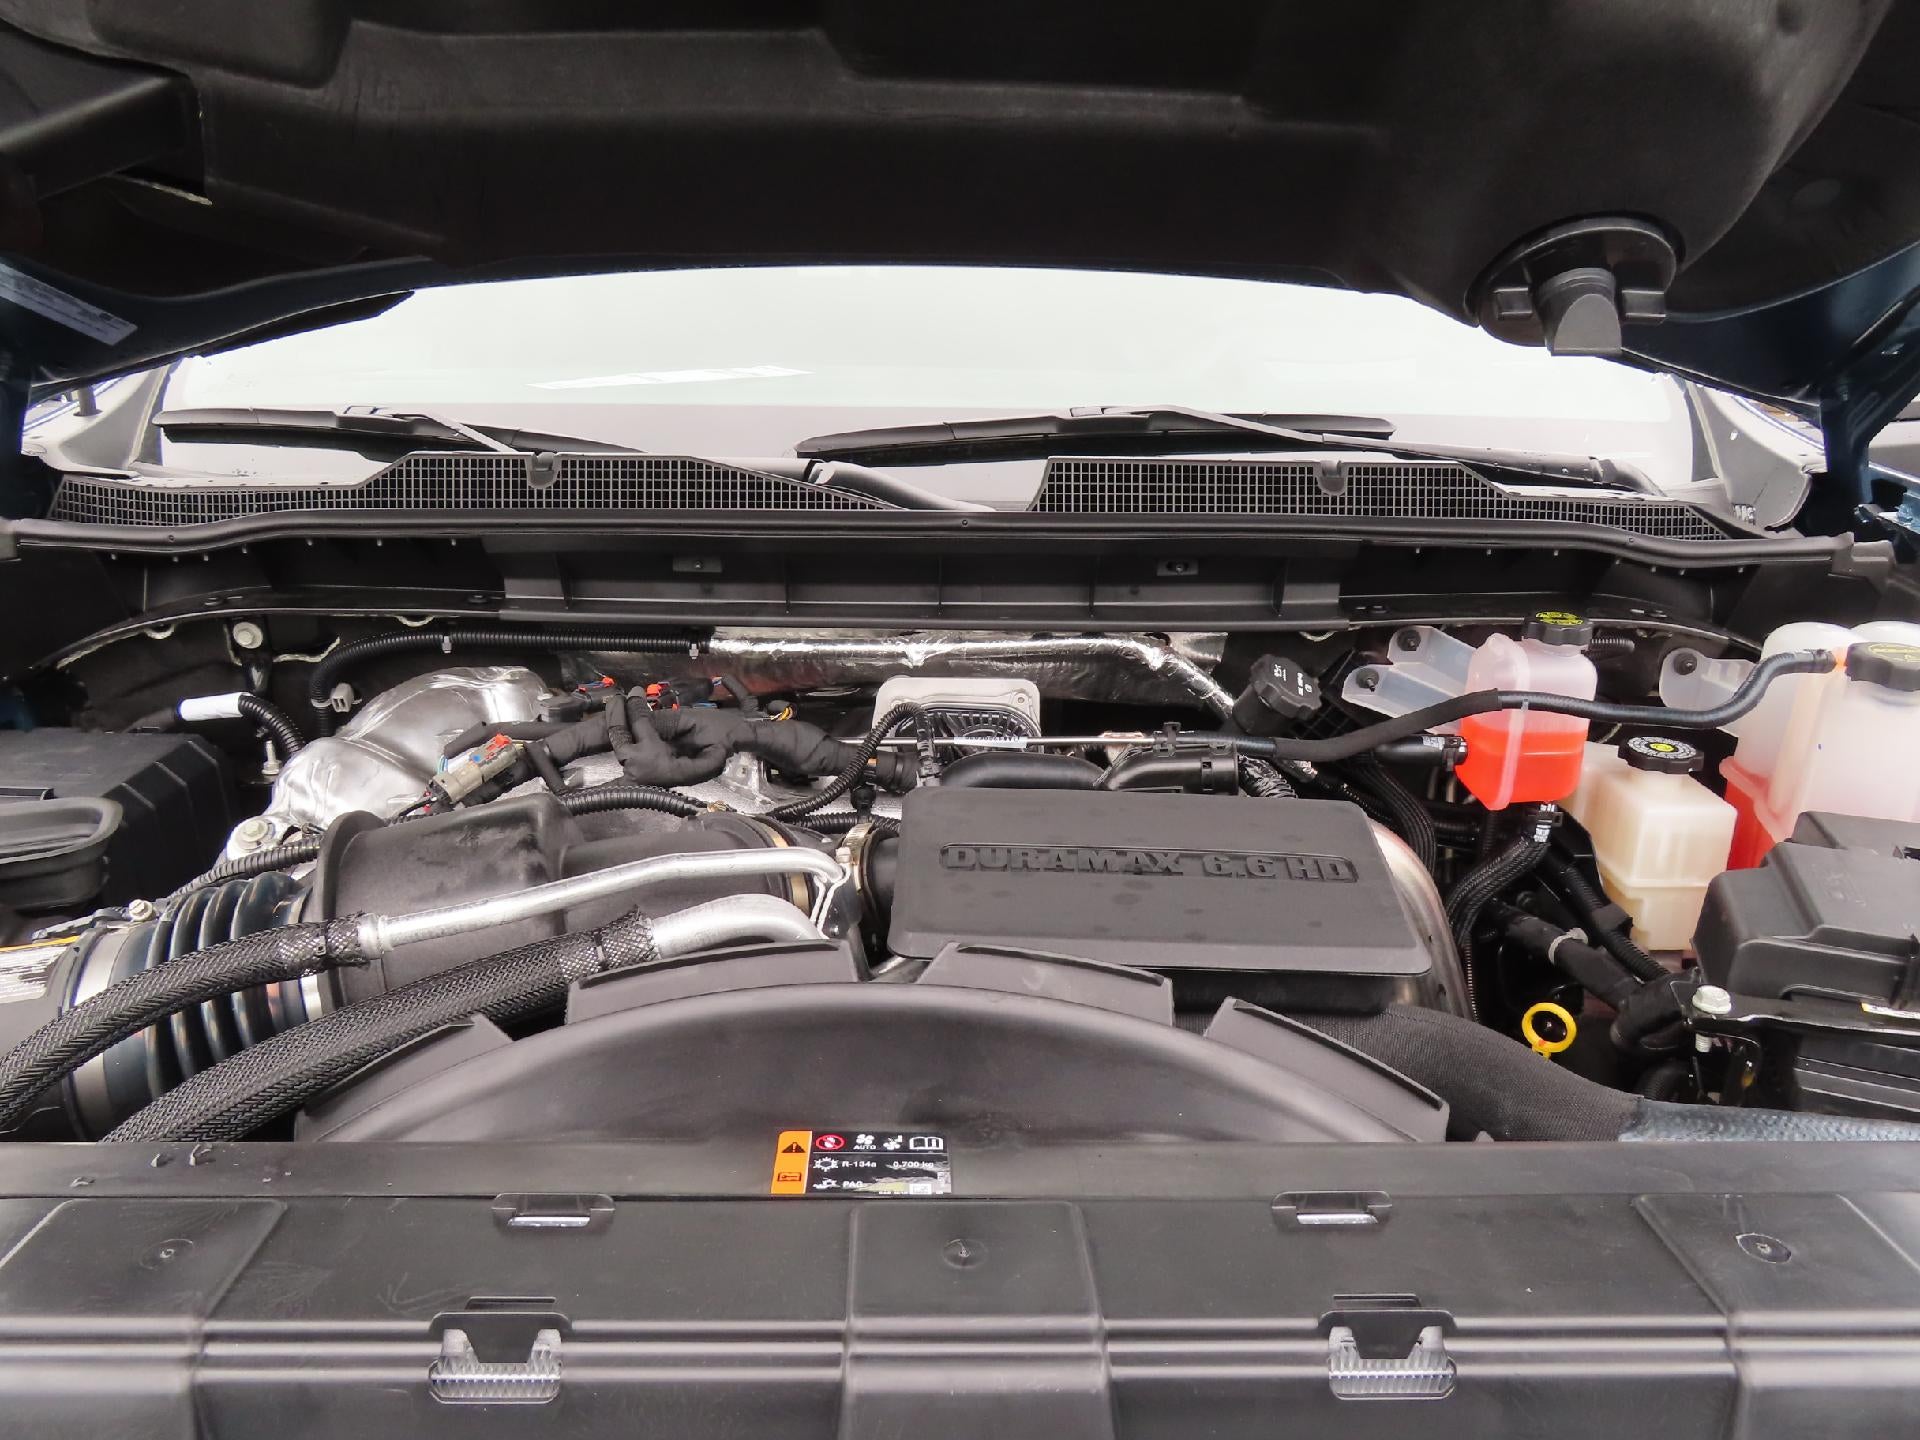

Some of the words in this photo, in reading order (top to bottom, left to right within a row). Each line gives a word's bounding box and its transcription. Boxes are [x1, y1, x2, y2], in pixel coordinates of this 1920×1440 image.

[945, 847, 1184, 876] DURAMAX
[1202, 853, 1277, 879] 6.6
[1285, 855, 1353, 882] HD
[841, 1160, 877, 1168] R-134a
[892, 1160, 920, 1168] 0.700
